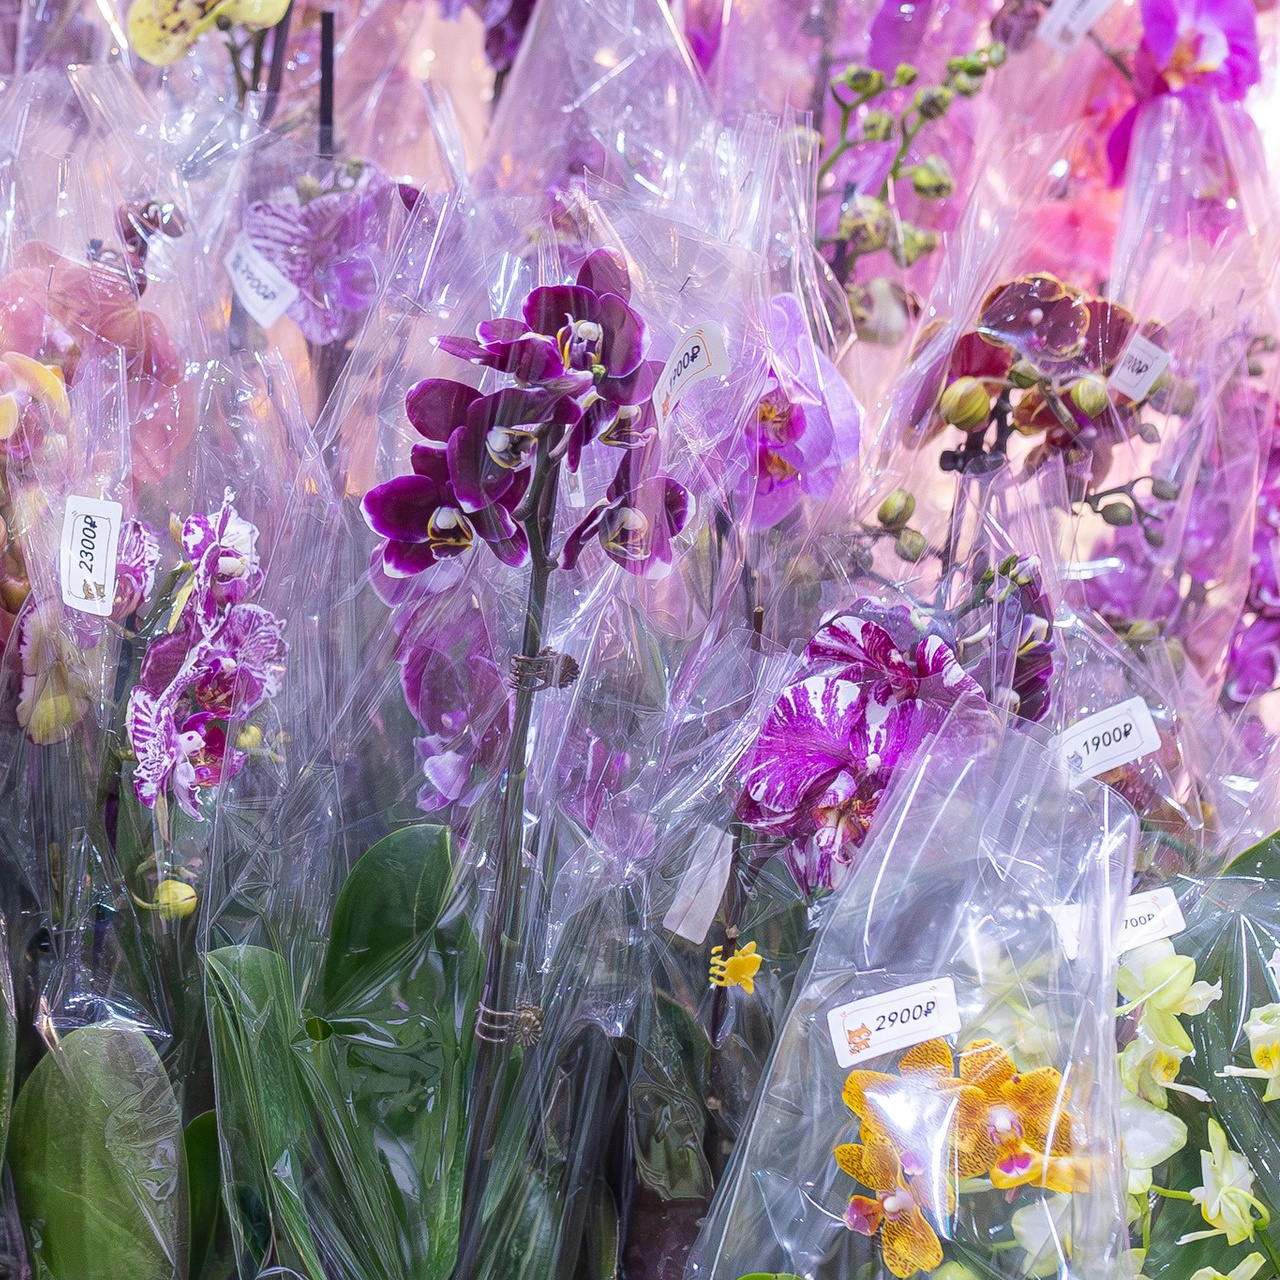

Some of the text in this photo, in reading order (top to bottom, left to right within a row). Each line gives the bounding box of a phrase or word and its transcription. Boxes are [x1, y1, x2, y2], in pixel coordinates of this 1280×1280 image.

[79, 515, 98, 574] 2300₽
[1082, 722, 1133, 756] 1900₽
[872, 1000, 934, 1032] 2900₽
